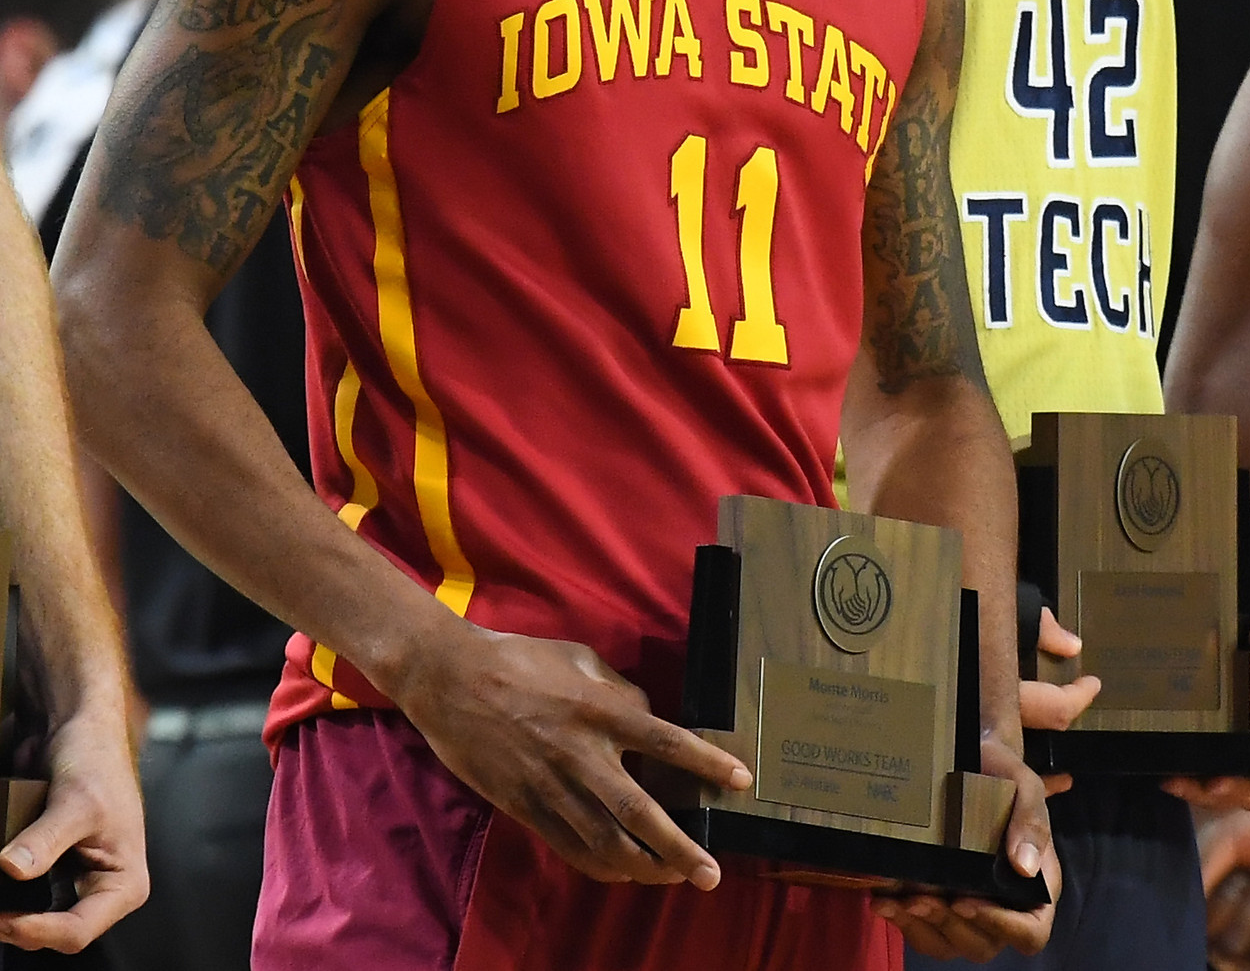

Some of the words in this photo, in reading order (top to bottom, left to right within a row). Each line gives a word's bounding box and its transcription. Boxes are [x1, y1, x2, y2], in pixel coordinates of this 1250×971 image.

[670, 133, 790, 367] 11
[963, 192, 1156, 339] TECH
[808, 677, 848, 697] Monte
[849, 685, 890, 704] Morris
[781, 739, 821, 759] GOOD
[823, 745, 872, 767] WORKS
[874, 753, 911, 774] TEAM
